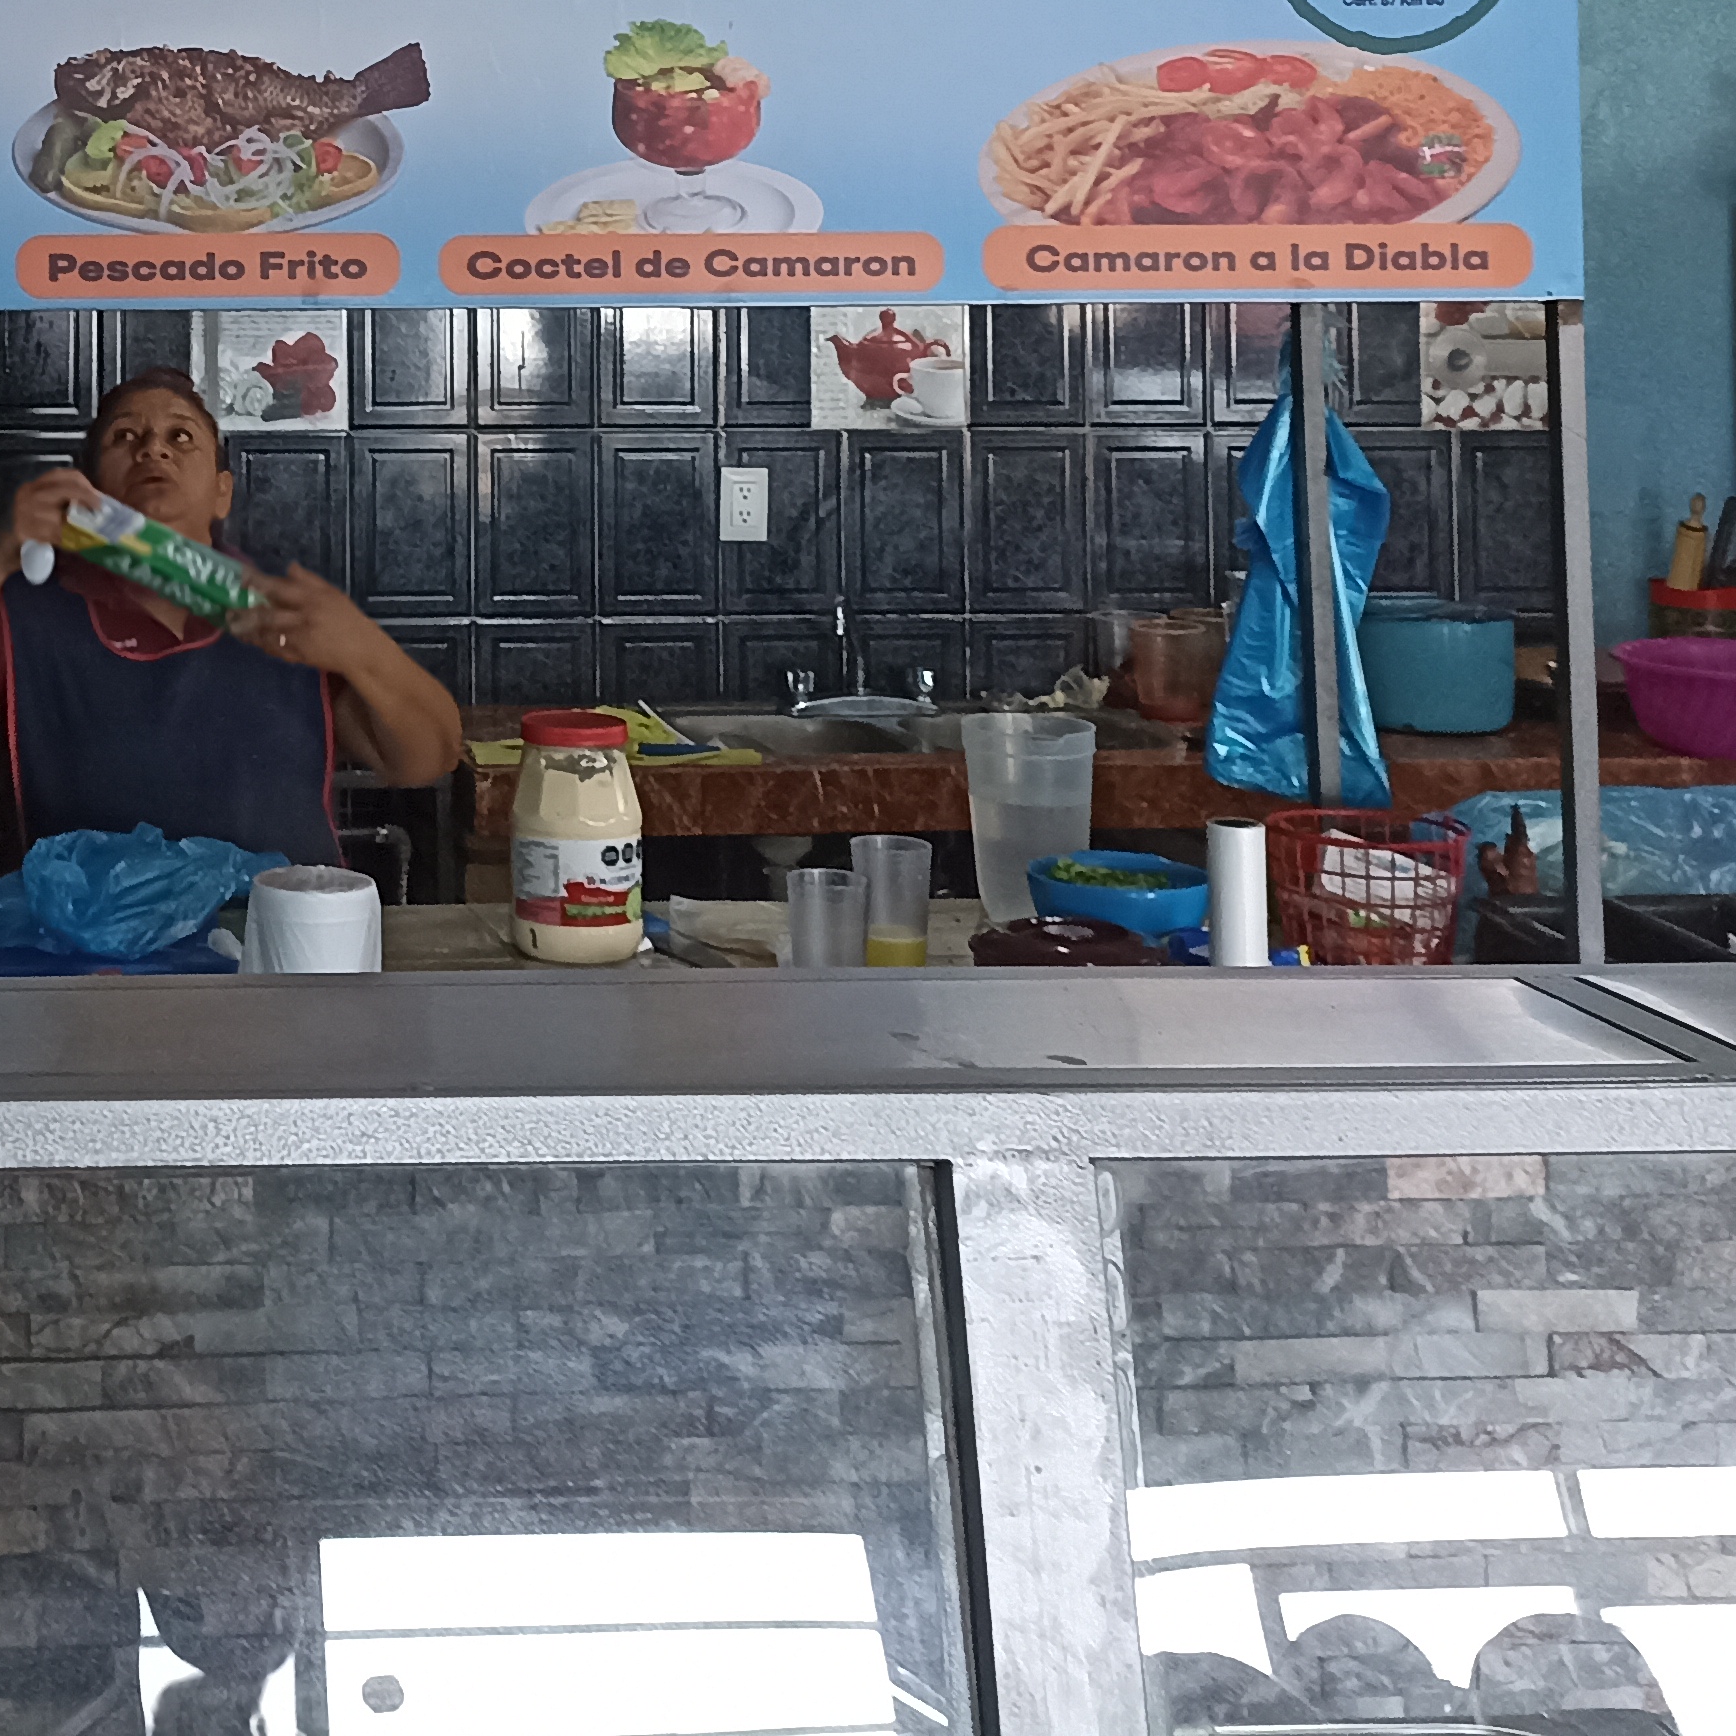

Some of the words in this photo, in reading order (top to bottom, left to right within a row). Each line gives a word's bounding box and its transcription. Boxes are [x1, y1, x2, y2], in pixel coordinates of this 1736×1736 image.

[48, 252, 246, 282] Pescado
[259, 250, 368, 280] Frito
[466, 250, 621, 280] Coctel
[635, 250, 691, 278] de
[704, 249, 917, 278] Camaron
[1026, 244, 1236, 273] Camaron
[1249, 251, 1276, 272] a
[1290, 242, 1329, 271] la
[1345, 242, 1490, 271] Diabla
